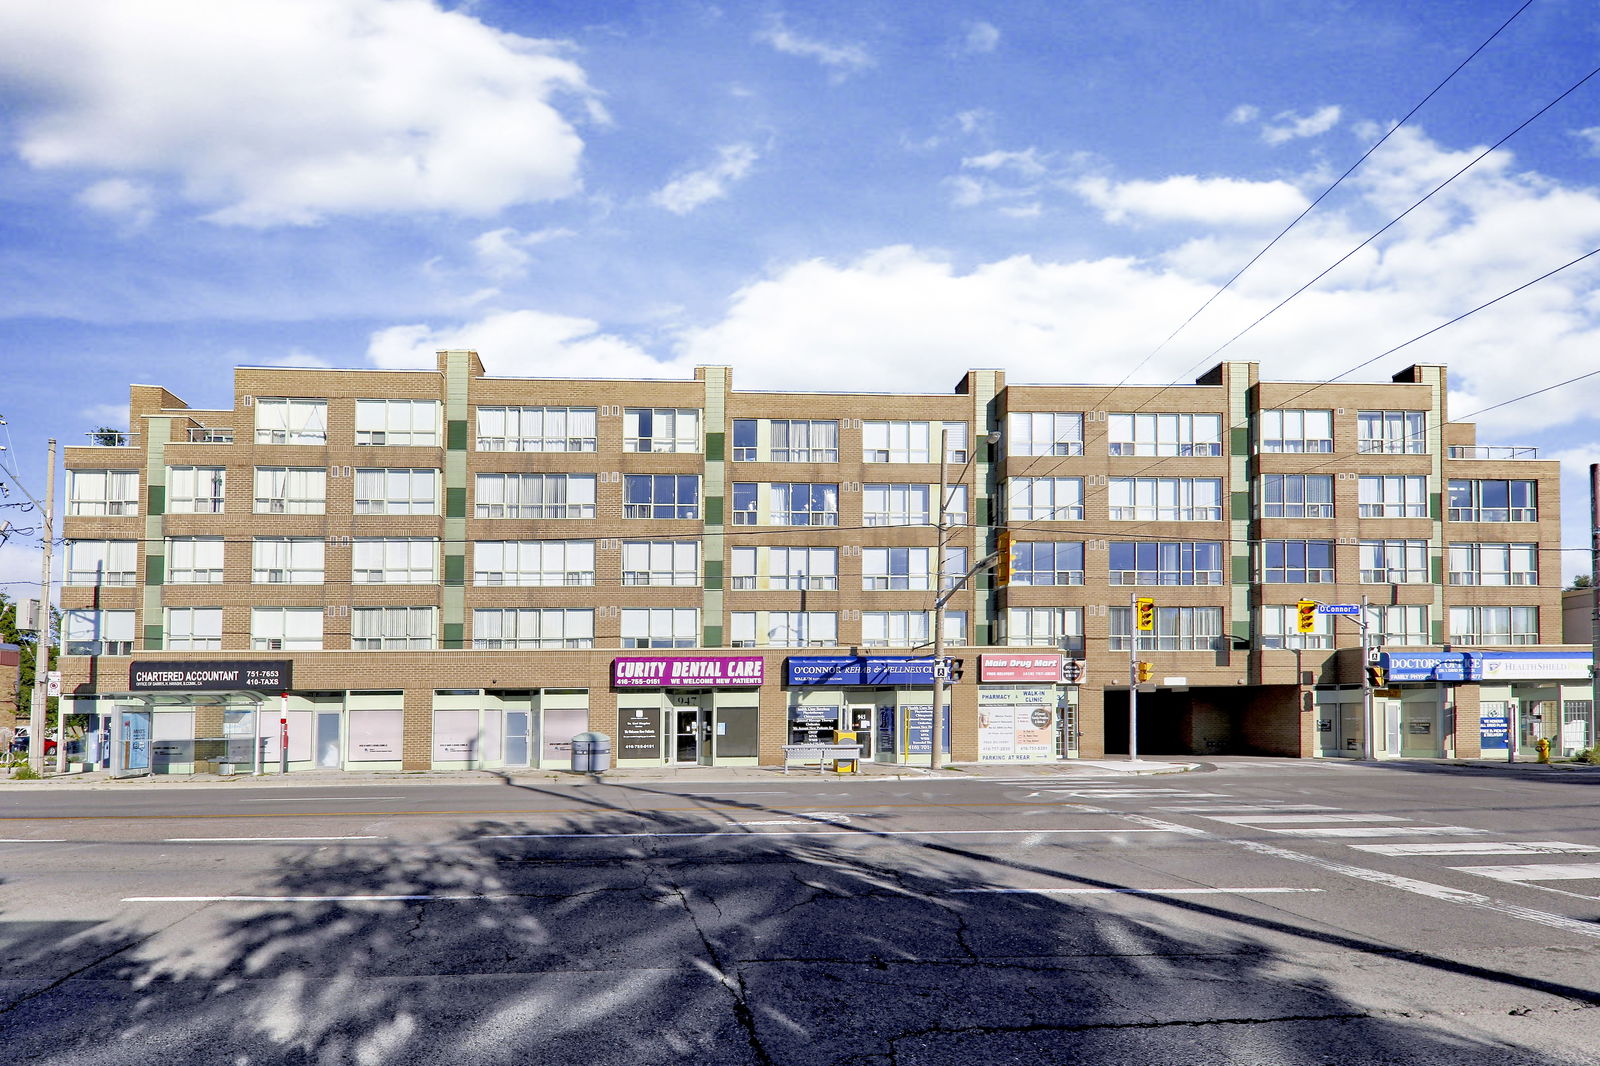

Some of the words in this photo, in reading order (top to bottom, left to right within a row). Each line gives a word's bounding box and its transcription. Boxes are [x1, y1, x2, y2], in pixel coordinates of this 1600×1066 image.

[1010, 660, 1032, 668] Drug
[1391, 658, 1441, 668] DOCTORS
[1444, 658, 1480, 668] OFFICE
[616, 662, 666, 677] CURITY
[672, 661, 722, 677] DENTAL
[727, 661, 762, 676] CARE
[883, 666, 922, 674] WELLNESS
[136, 671, 184, 682] CHARTERED
[185, 671, 239, 681] ACCOUNTANT
[677, 696, 697, 706] 947
